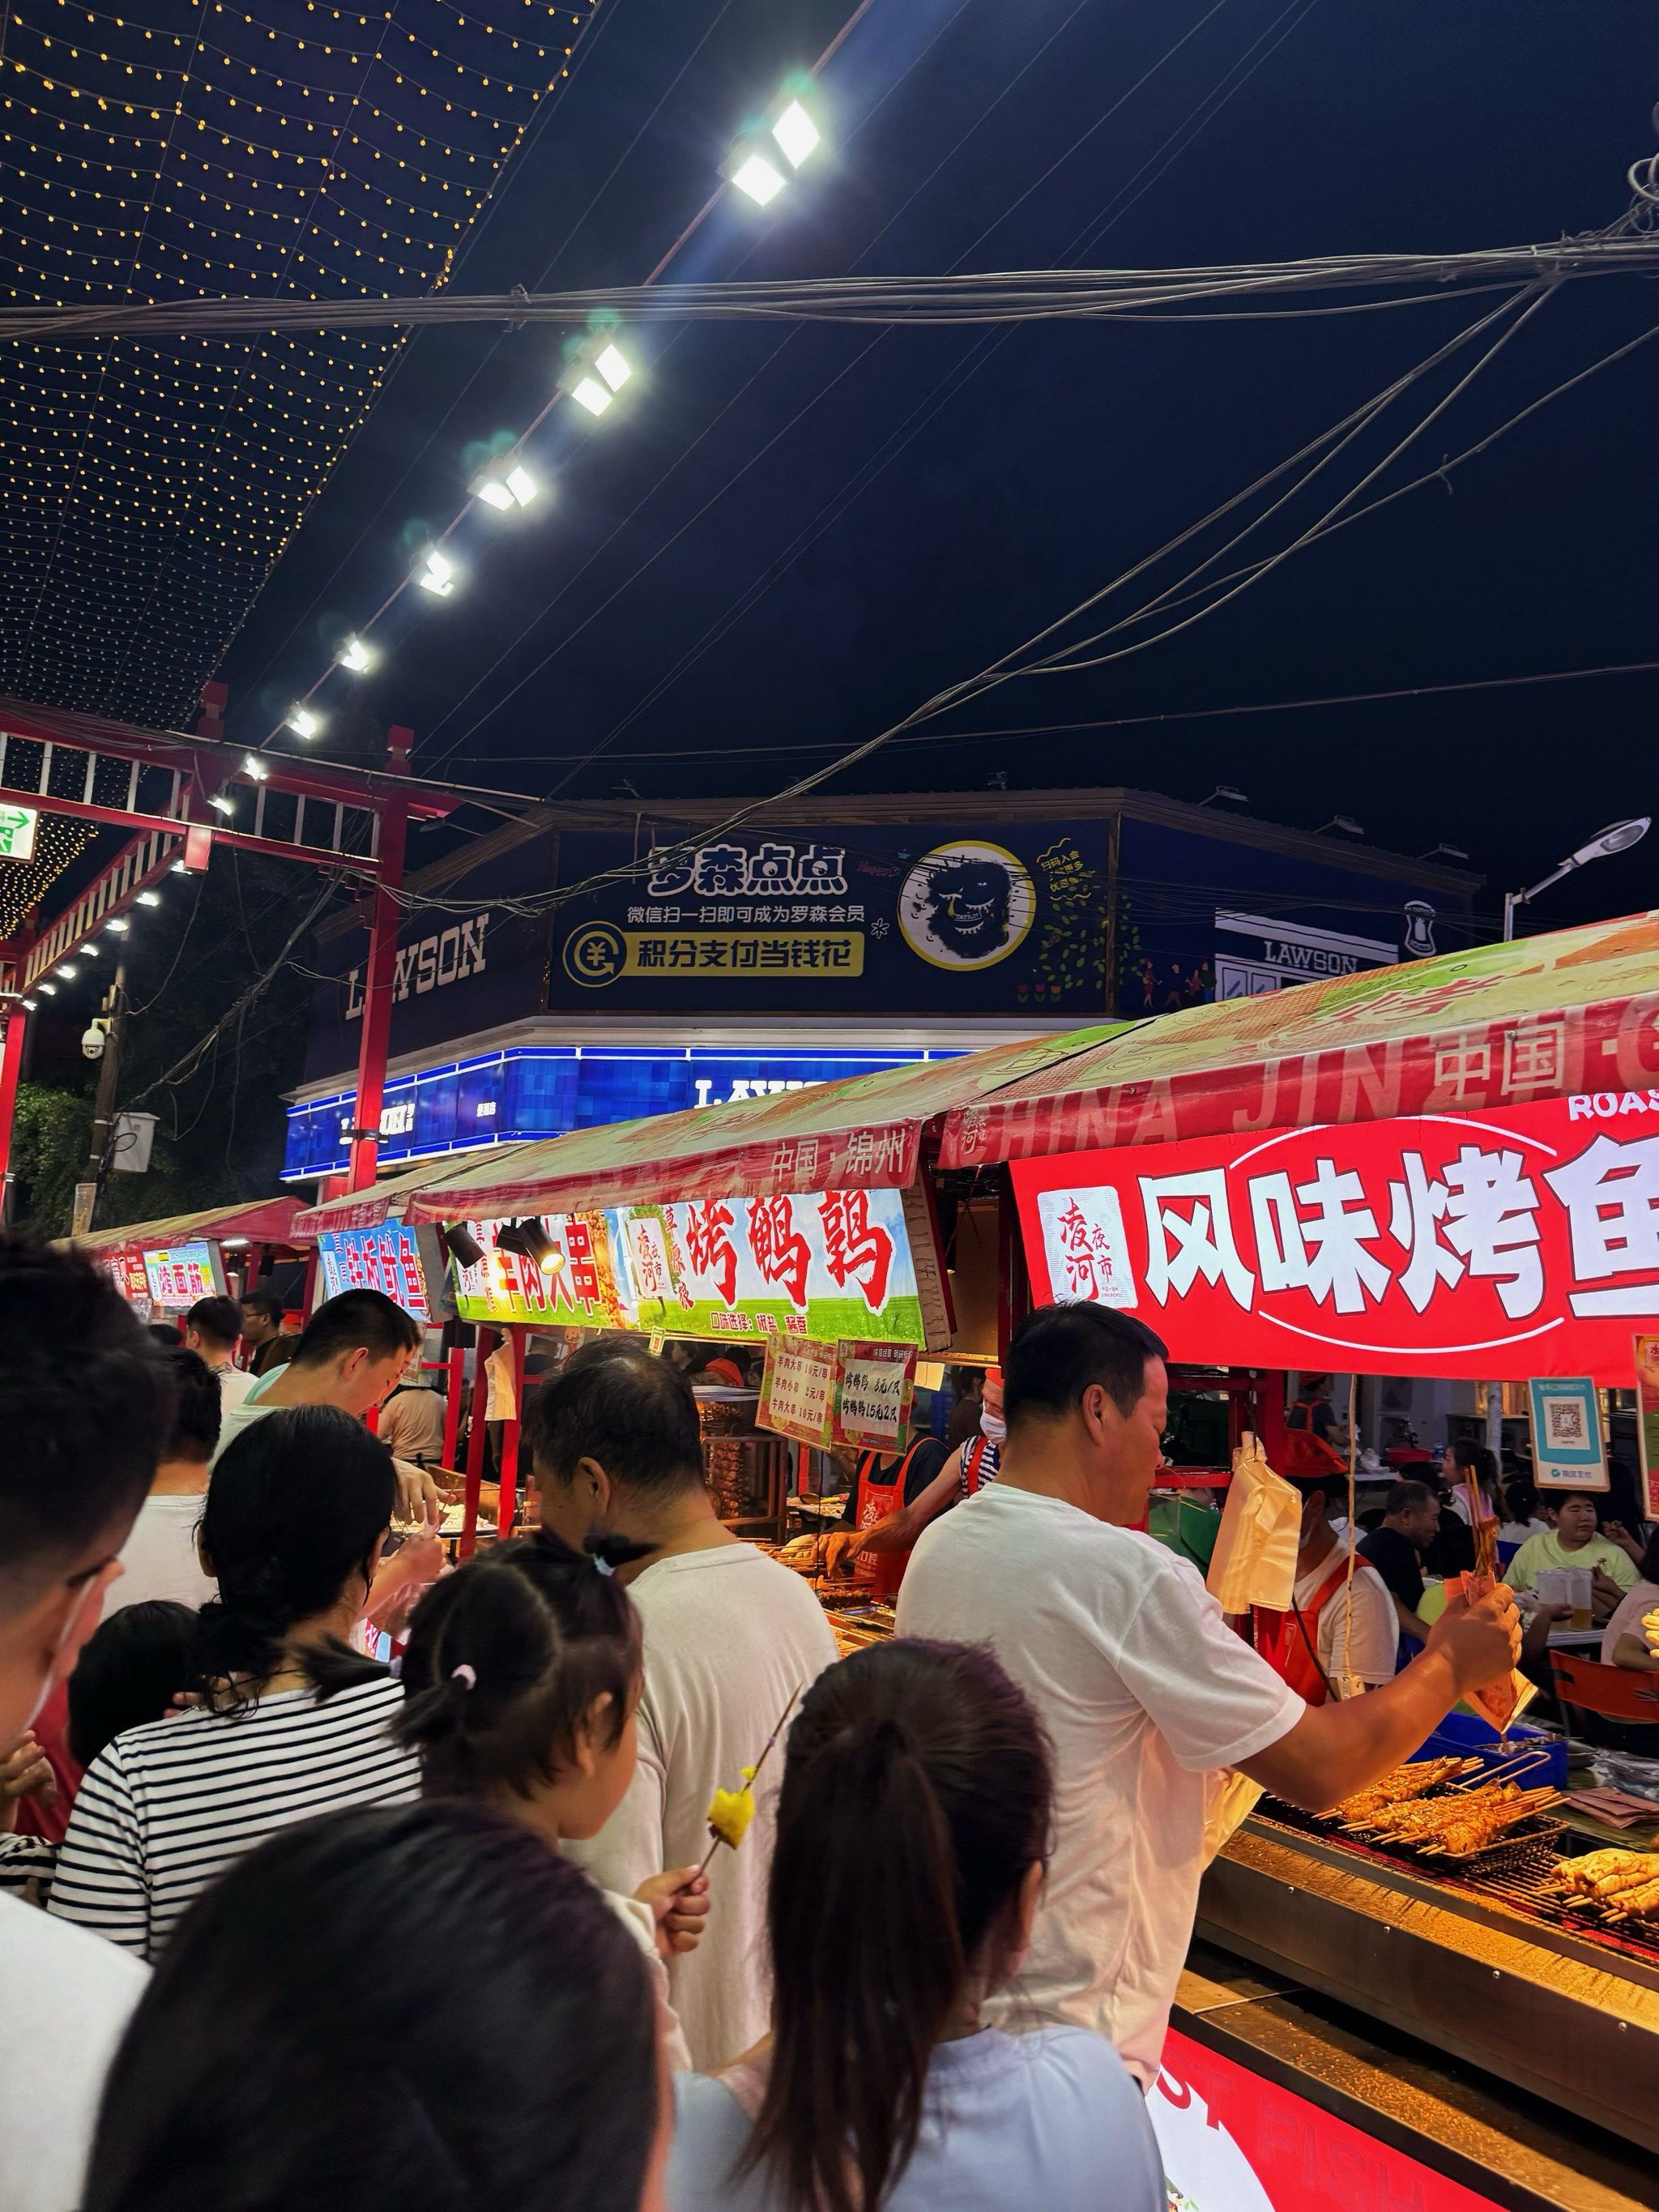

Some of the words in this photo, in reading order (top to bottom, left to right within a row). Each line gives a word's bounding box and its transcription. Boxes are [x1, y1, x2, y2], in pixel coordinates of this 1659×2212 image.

[648, 843, 848, 897] 罗森点点
[627, 905, 865, 924] 微信扫一扫即可成为罗森会员
[346, 913, 489, 1020] LWSON
[638, 939, 851, 967] 积分支付当钱花
[1264, 941, 1358, 975] LAWSON
[1137, 1131, 1659, 1320] 风味烤鱼
[778, 1355, 802, 1373] 羊肉大串
